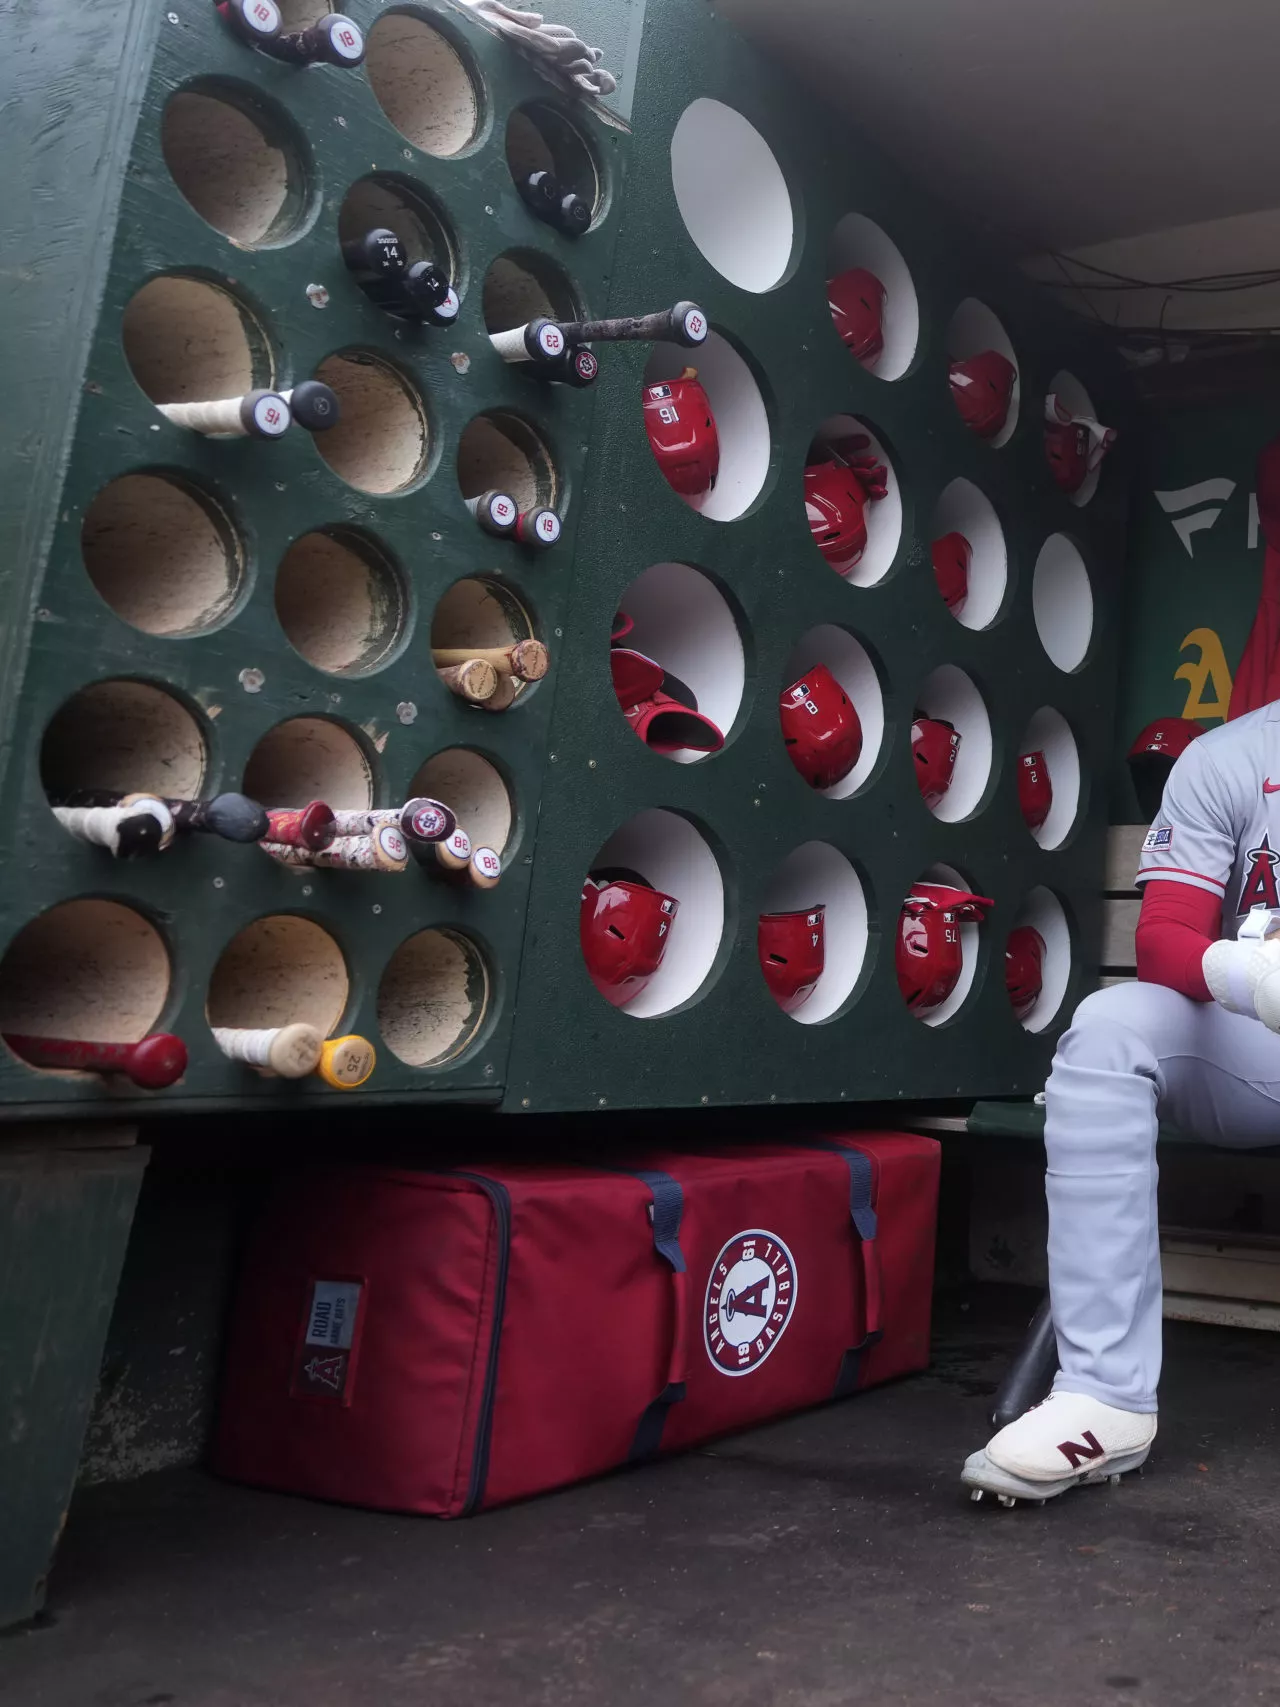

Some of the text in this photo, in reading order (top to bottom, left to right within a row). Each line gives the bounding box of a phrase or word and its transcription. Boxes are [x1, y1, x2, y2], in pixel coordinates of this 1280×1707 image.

[253, 3, 270, 22] 18
[338, 31, 355, 48] 18
[383, 246, 398, 259] 14
[689, 315, 702, 333] 23
[545, 334, 560, 349] 23
[659, 406, 680, 425] 16
[542, 518, 554, 532] 19
[804, 700, 819, 716] 8
[1154, 732, 1164, 741] 5
[1030, 770, 1038, 783] 2
[423, 813, 438, 830] 35
[811, 933, 819, 948] 4
[346, 1054, 361, 1073] 25
[742, 1240, 756, 1260] 61
[756, 1242, 791, 1354] BASEBALL
[709, 1263, 728, 1355] ANGELS
[312, 1301, 332, 1338] ROAD
[738, 1342, 750, 1365] 19
[1056, 1430, 1105, 1470] N
